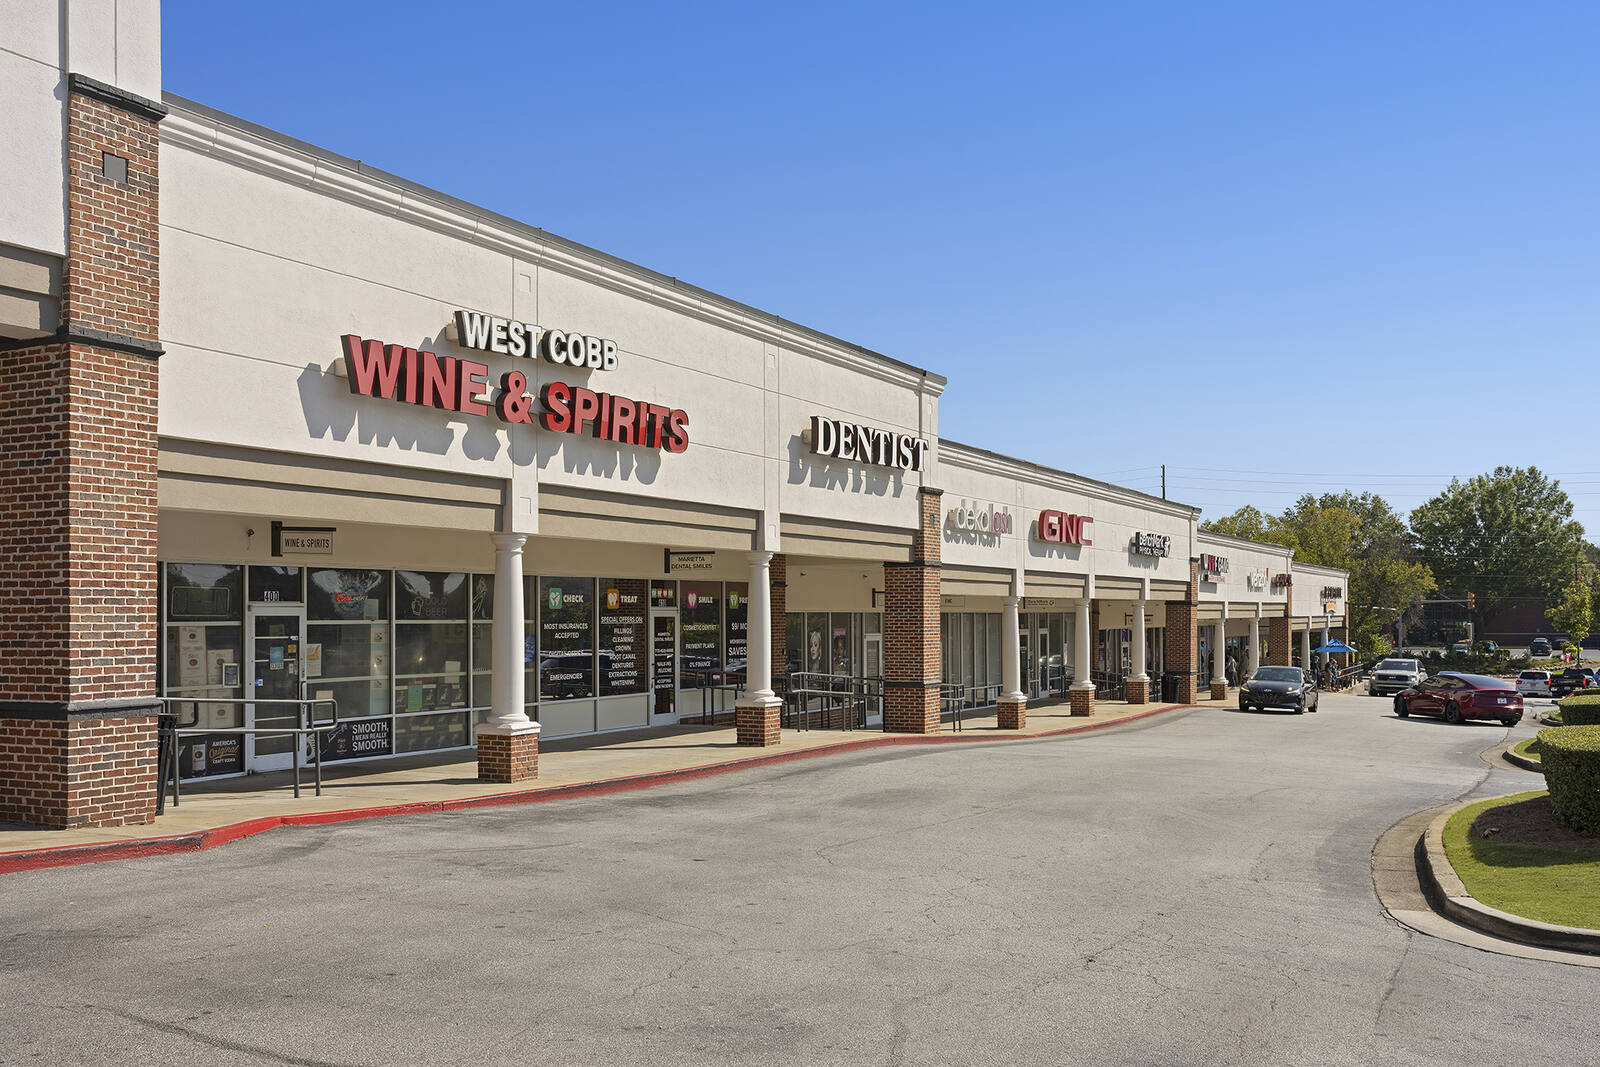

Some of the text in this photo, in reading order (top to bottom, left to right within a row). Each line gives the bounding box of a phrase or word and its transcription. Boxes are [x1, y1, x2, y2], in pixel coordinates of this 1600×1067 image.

[455, 310, 619, 371] WEST COBB
[341, 334, 690, 454] WINE & SPIRITS
[810, 416, 929, 472] DENTIST
[1039, 509, 1094, 546] GNC
[285, 538, 300, 548] WINE
[307, 538, 330, 549] SPIRITS
[264, 591, 279, 602] 400
[563, 595, 584, 603] CHECK
[620, 595, 638, 603] TREAT
[698, 596, 713, 604] SMILE
[600, 616, 618, 624] SPECIAL
[619, 616, 636, 624] OFFERS
[559, 622, 589, 630] INSURANCES
[613, 627, 633, 635] FILLINGS
[728, 646, 747, 656] SAVES
[611, 661, 634, 669] DENTURES
[549, 672, 583, 681] EMERGENCIES
[608, 670, 638, 678] EXTRACTIONS
[352, 721, 389, 735] SMOOTH,
[212, 739, 236, 747] AMERICA'S
[352, 739, 389, 752] SMOOTH.
[208, 744, 240, 758] Original
